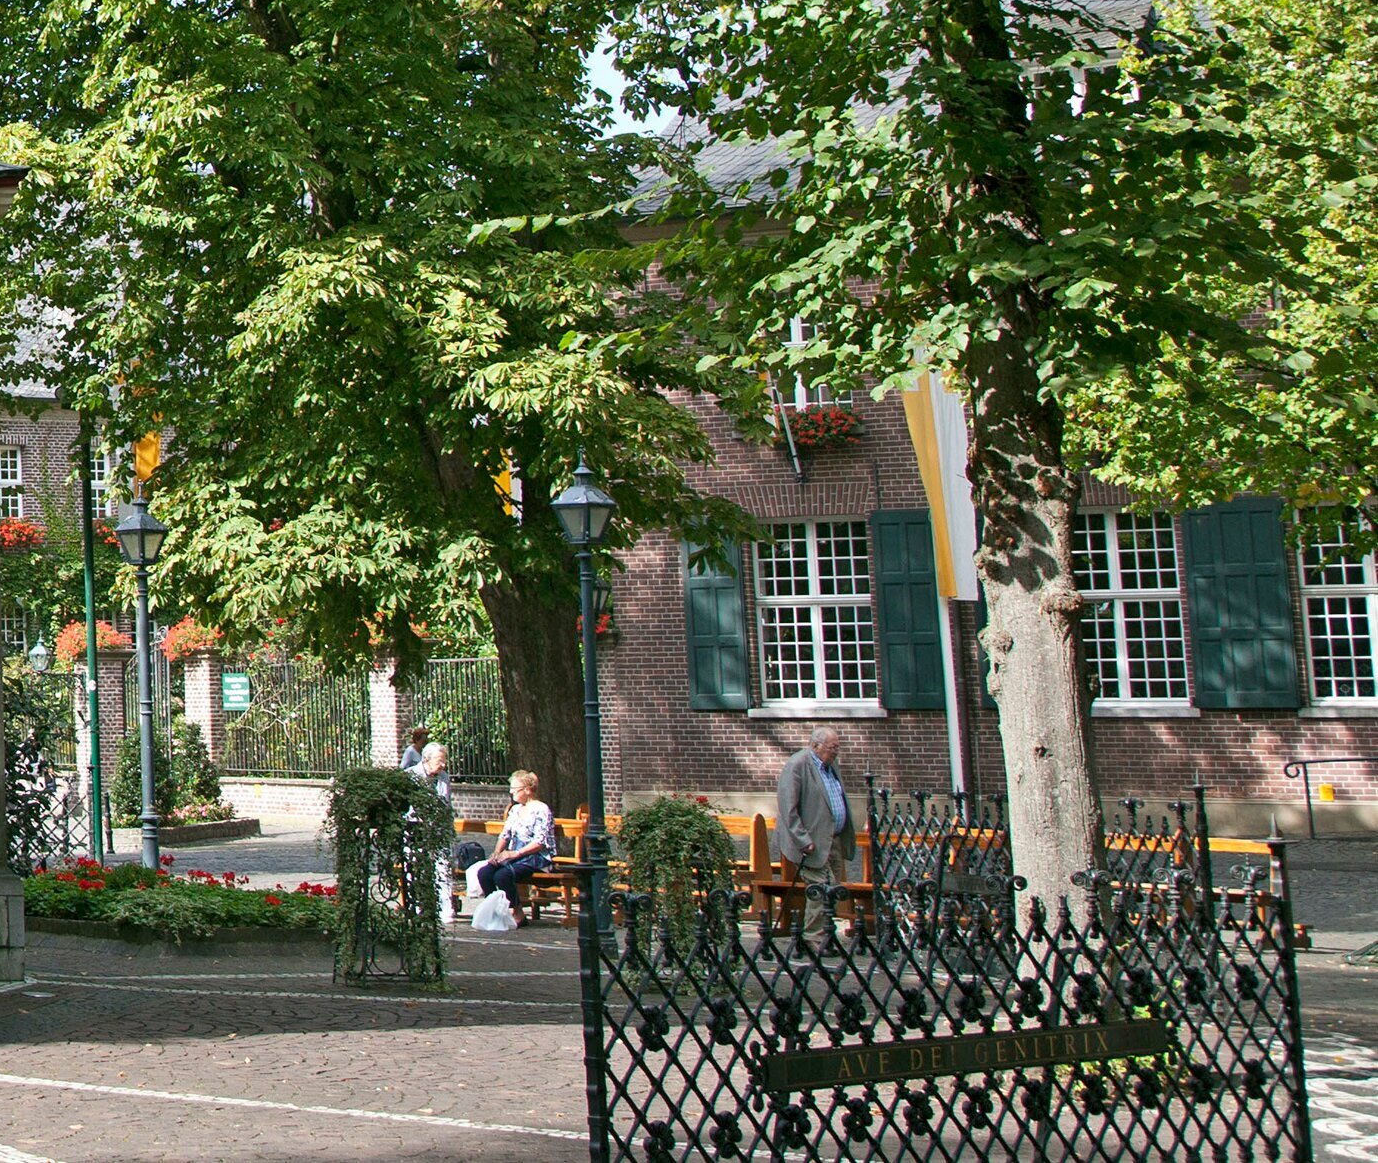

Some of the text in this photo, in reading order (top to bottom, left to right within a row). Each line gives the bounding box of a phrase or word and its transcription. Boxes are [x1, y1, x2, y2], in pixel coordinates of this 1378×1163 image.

[838, 1030, 1109, 1079] AVE DEI GENITRIX
